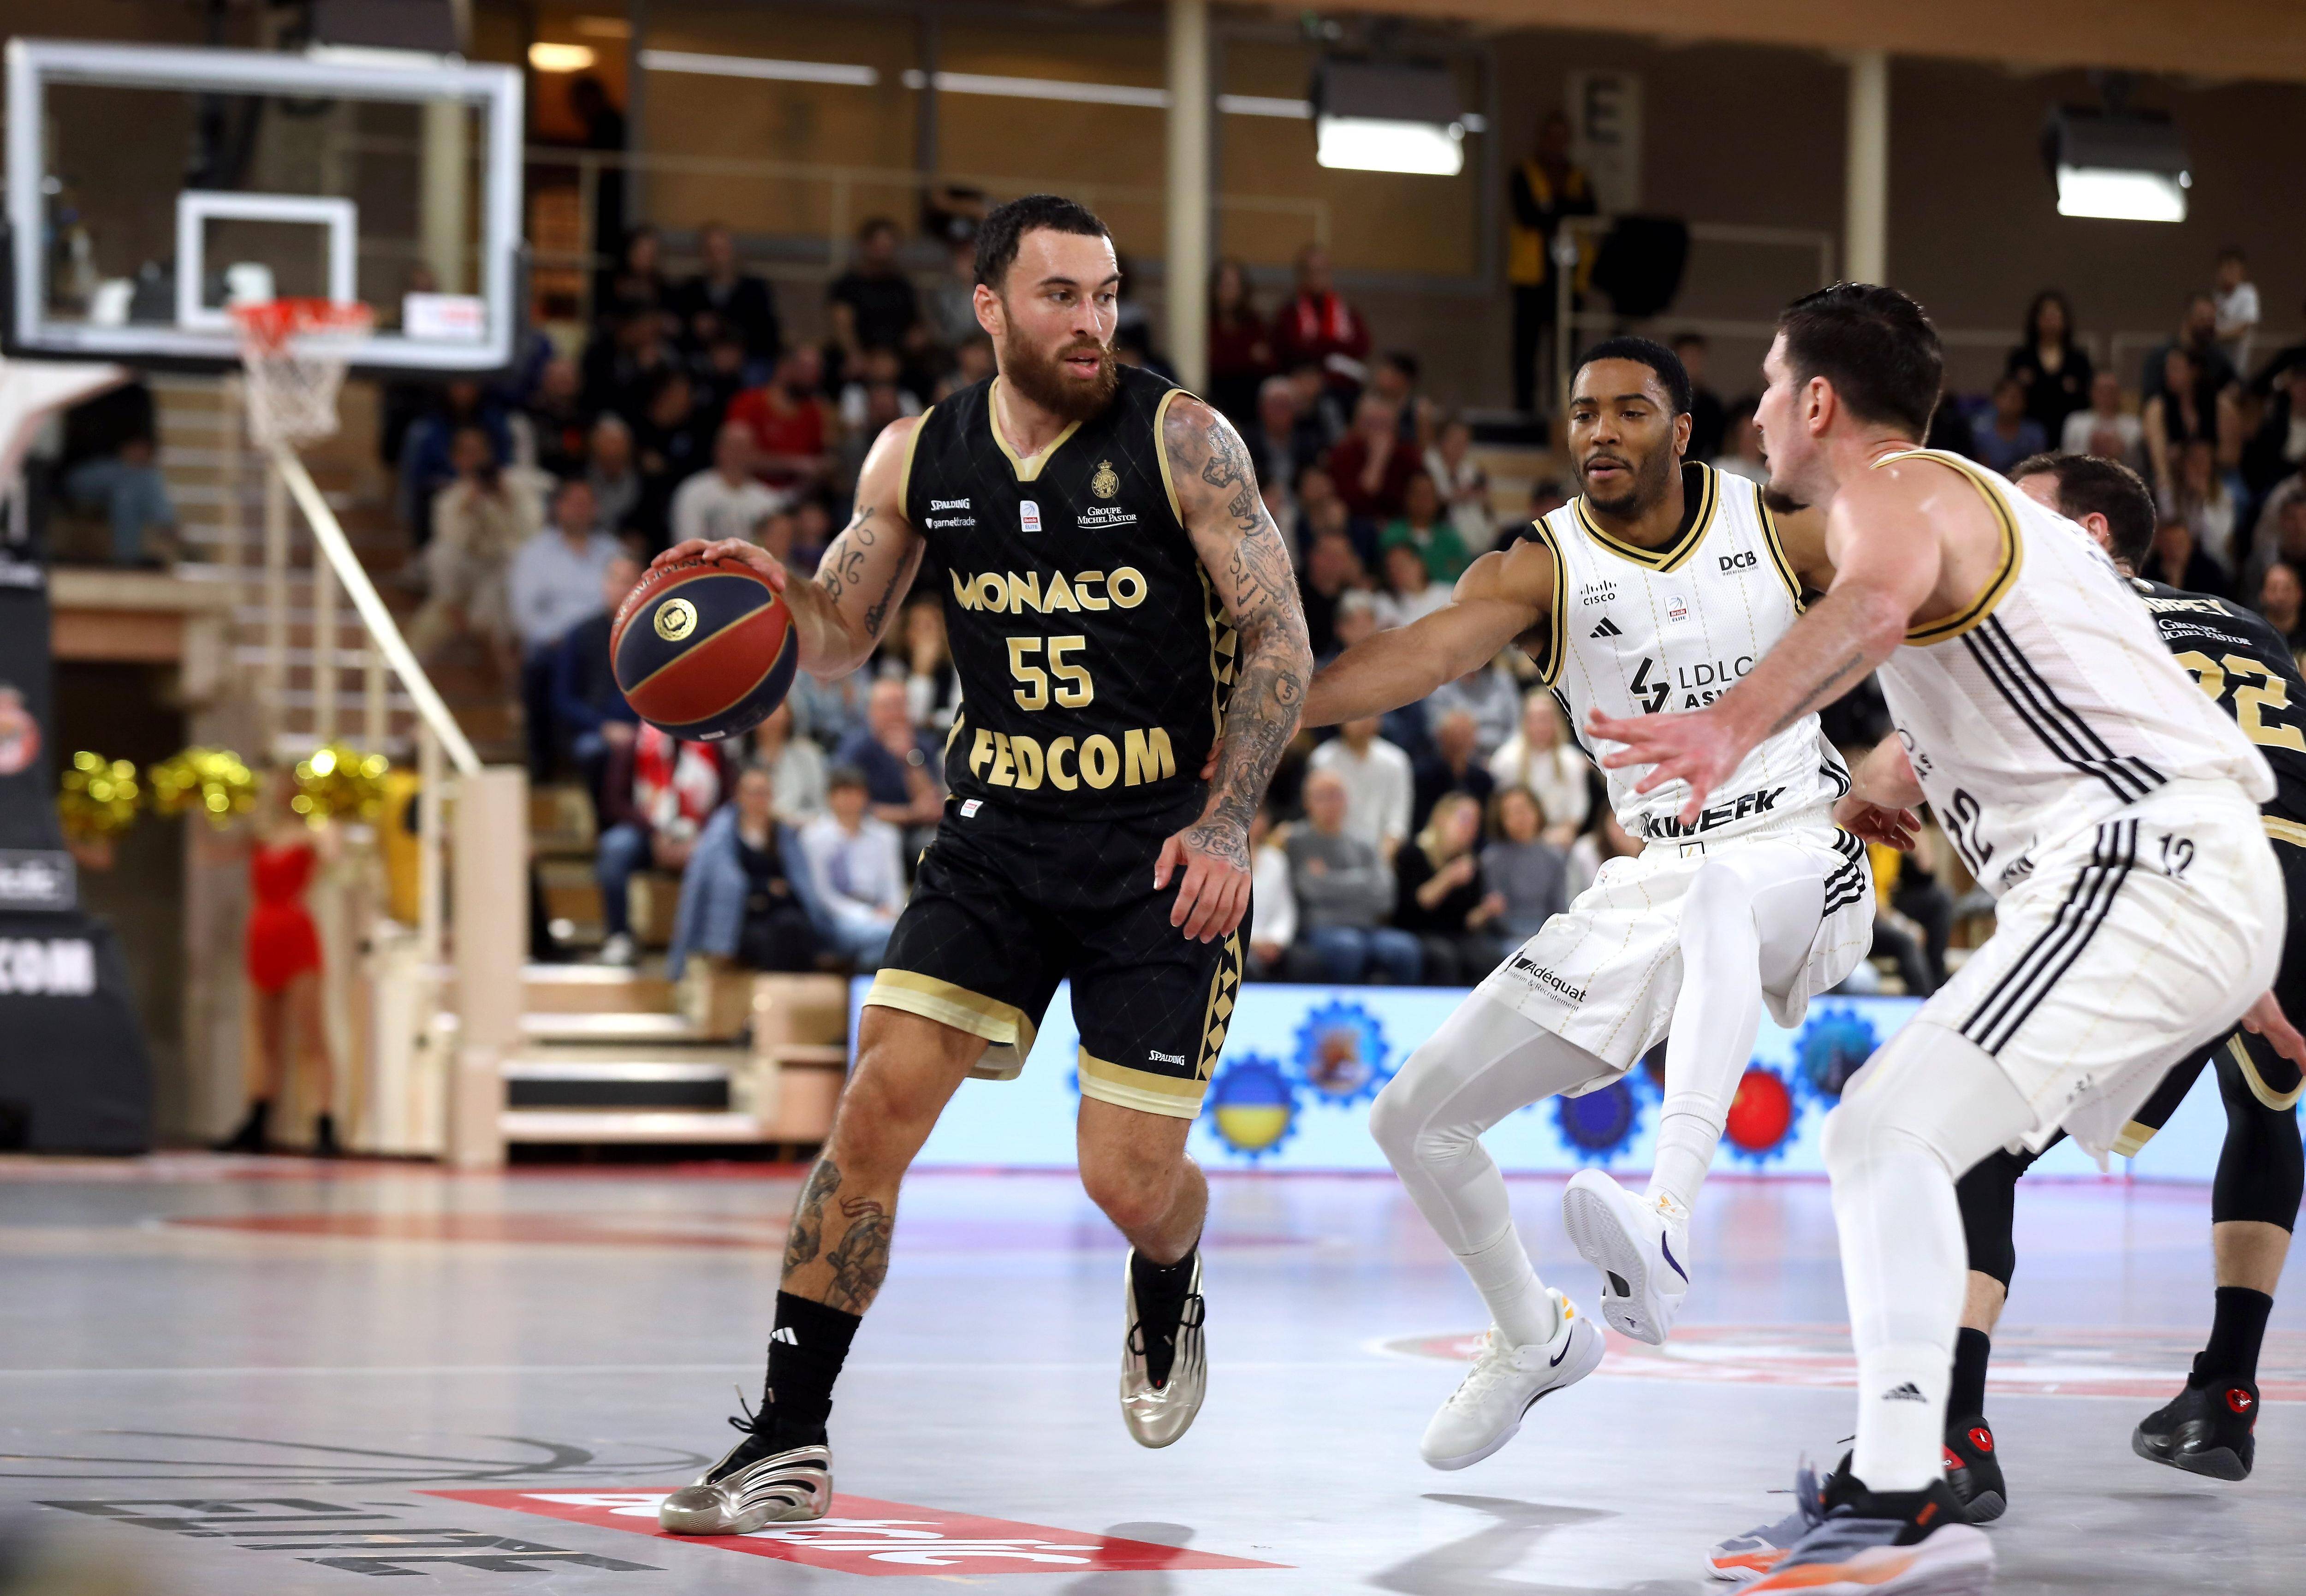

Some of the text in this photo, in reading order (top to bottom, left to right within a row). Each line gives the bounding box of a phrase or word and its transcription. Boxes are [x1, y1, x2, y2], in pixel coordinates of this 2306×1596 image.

[931, 498, 970, 510] SPALDING
[1088, 507, 1122, 516] GROUPE
[933, 517, 975, 528] garnettrade
[1077, 514, 1137, 524] MICHEL PASTOR
[1719, 551, 1757, 571] DCB
[949, 566, 1147, 614] MONACO
[1583, 593, 1616, 605] CISCO
[2158, 630, 2205, 641] ICHEL
[1006, 636, 1093, 710] 55
[1679, 656, 1753, 689] LDLC
[969, 727, 1176, 790] FEDCOM
[1523, 963, 1587, 1002] Adéquat
[1148, 1050, 1185, 1066] SPALDING
